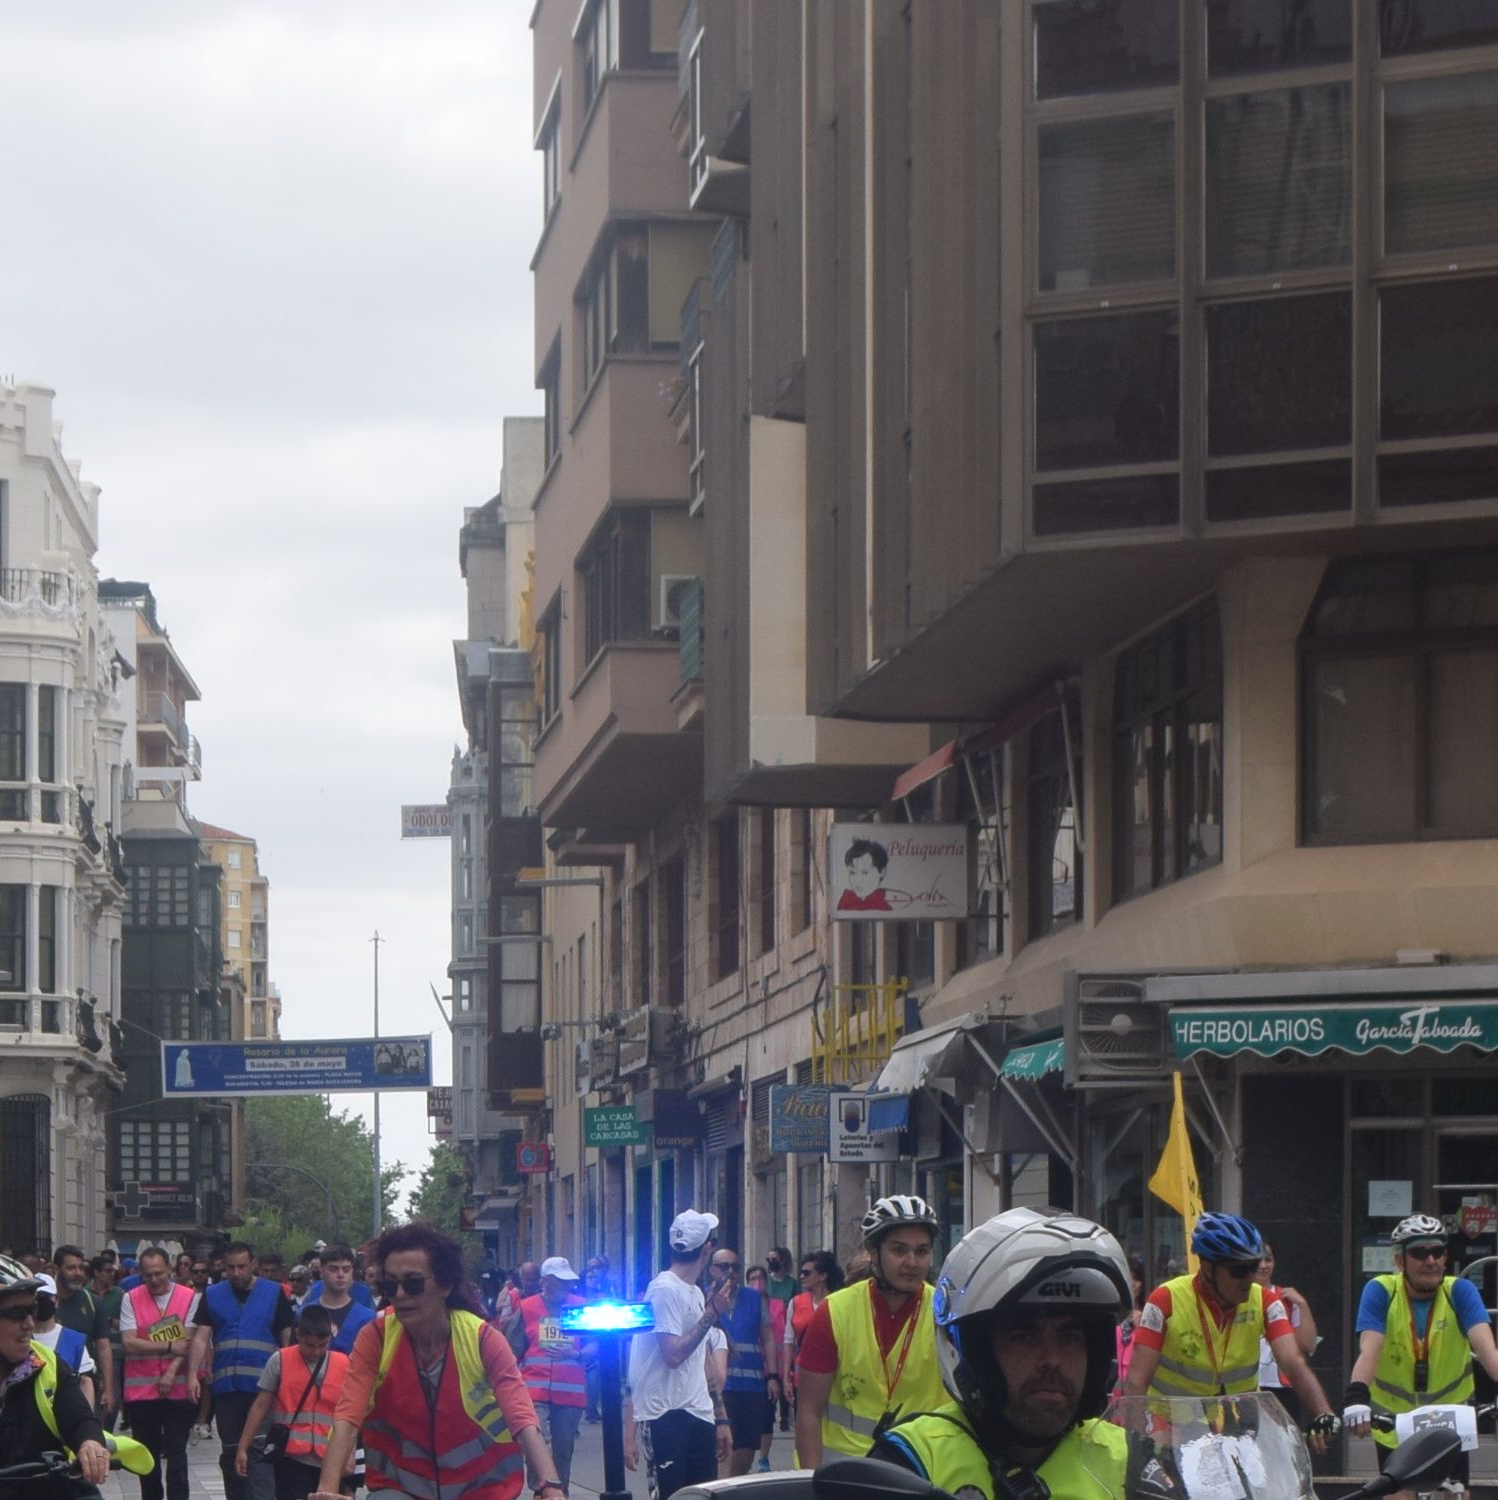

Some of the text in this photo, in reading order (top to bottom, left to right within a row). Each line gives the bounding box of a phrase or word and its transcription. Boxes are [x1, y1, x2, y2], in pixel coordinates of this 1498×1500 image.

[1175, 1017, 1325, 1045] HERBOLARIOS
[1400, 1006, 1483, 1046] Taboada
[243, 1046, 348, 1057] Rosario de la Aurora
[249, 1060, 288, 1070] Sábado,
[304, 1060, 315, 1068] de
[317, 1059, 343, 1069] mayo
[593, 1112, 634, 1122] LA CASA
[596, 1122, 632, 1131] DE LAS
[589, 1130, 639, 1140] CARCASAS
[656, 1137, 694, 1147] orange
[839, 1142, 872, 1150] Apuestas
[1038, 1282, 1081, 1297] GIVI
[152, 1324, 181, 1342] 0700
